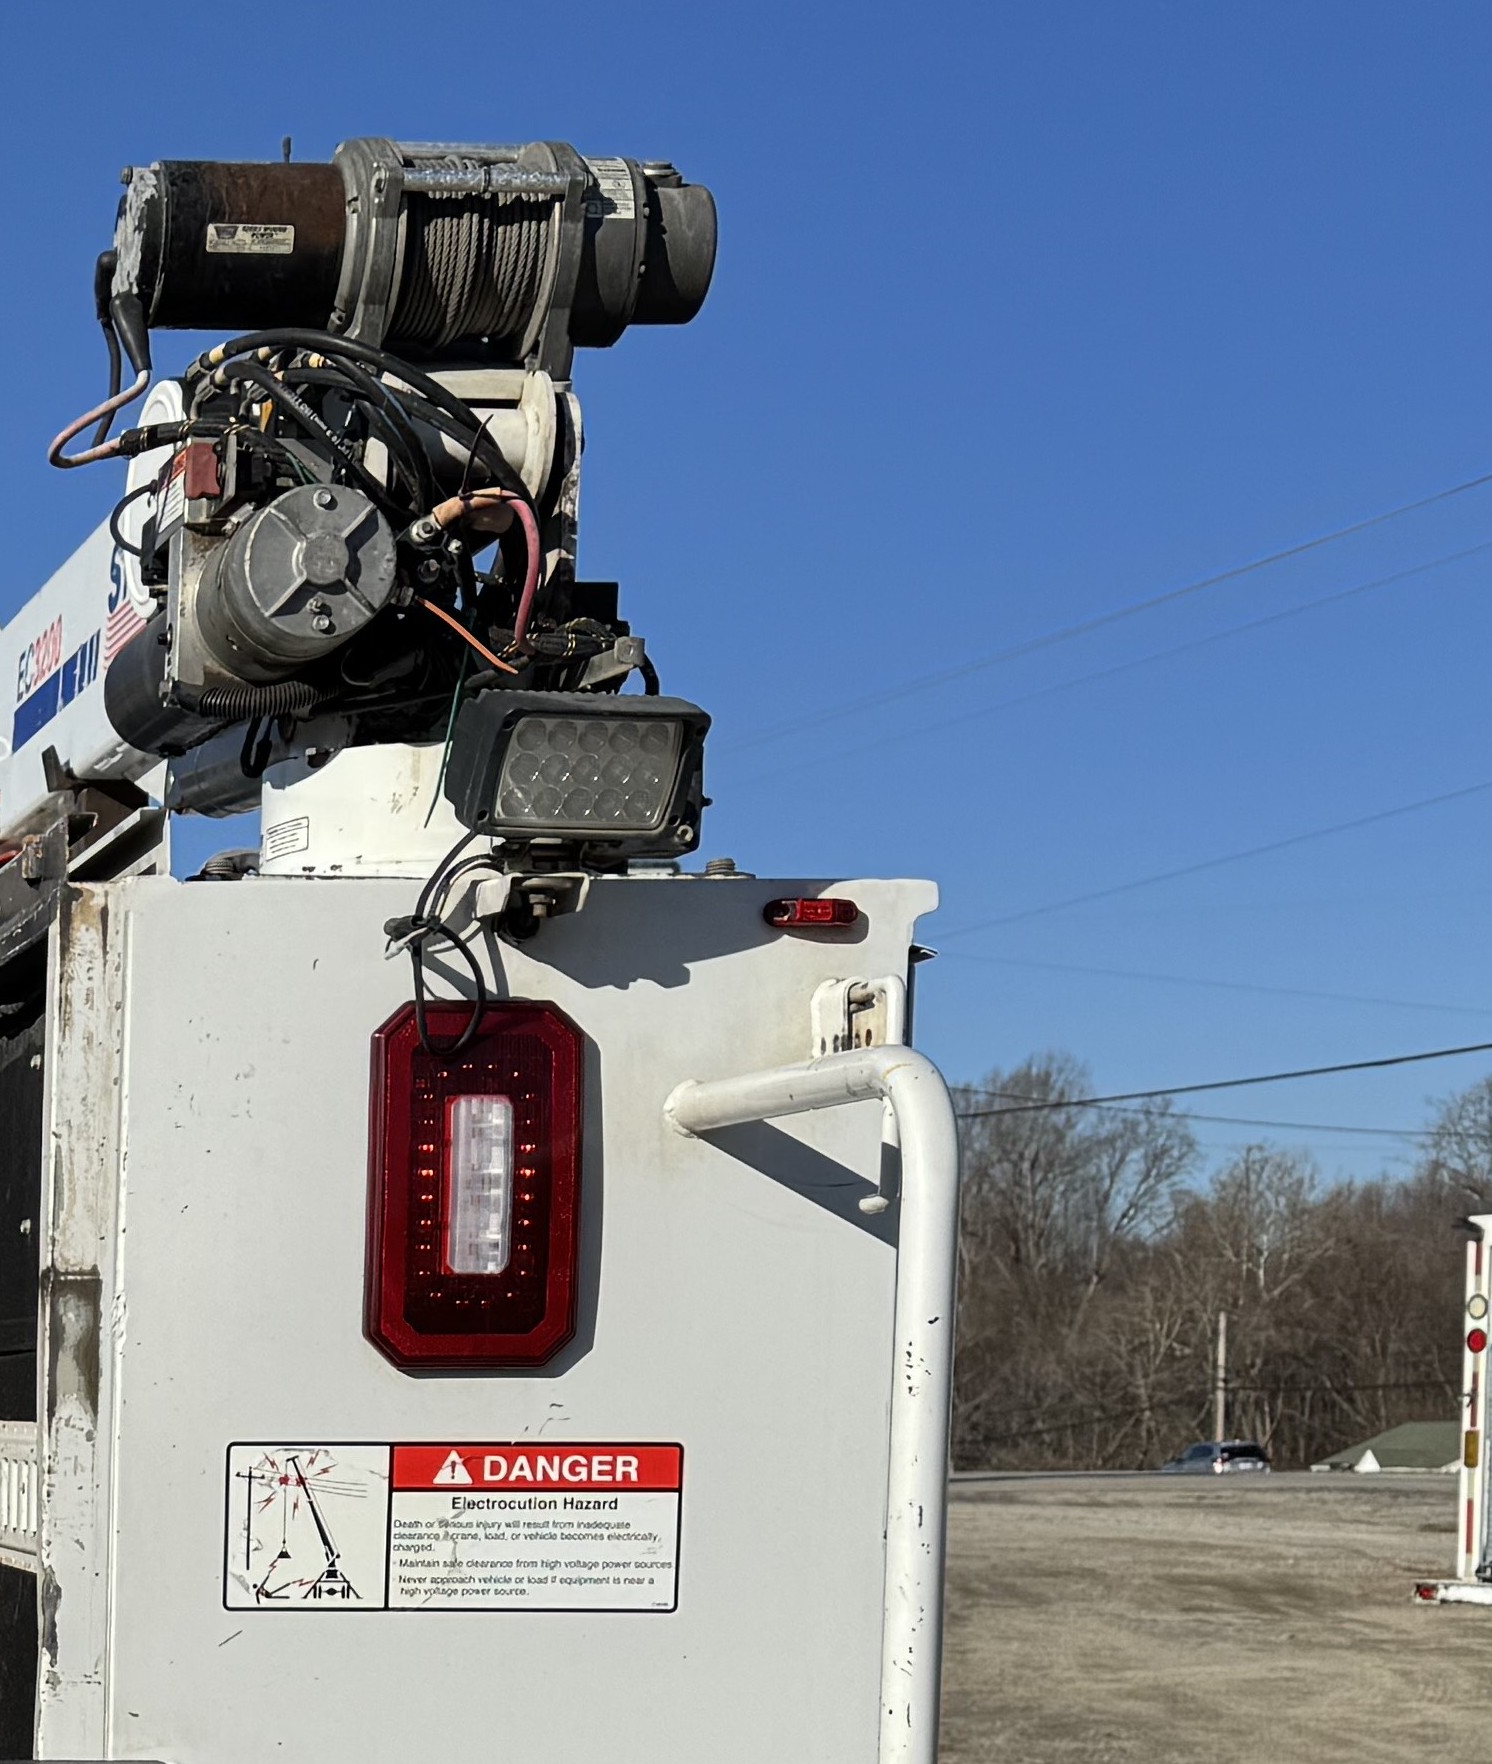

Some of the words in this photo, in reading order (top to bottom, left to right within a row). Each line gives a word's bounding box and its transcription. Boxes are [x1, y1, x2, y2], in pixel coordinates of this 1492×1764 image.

[483, 1455, 639, 1482] DANGER
[451, 1496, 558, 1510] Electrocution
[563, 1496, 619, 1510] Hazard
[399, 1558, 440, 1568] Maintain
[398, 1575, 427, 1584] Never
